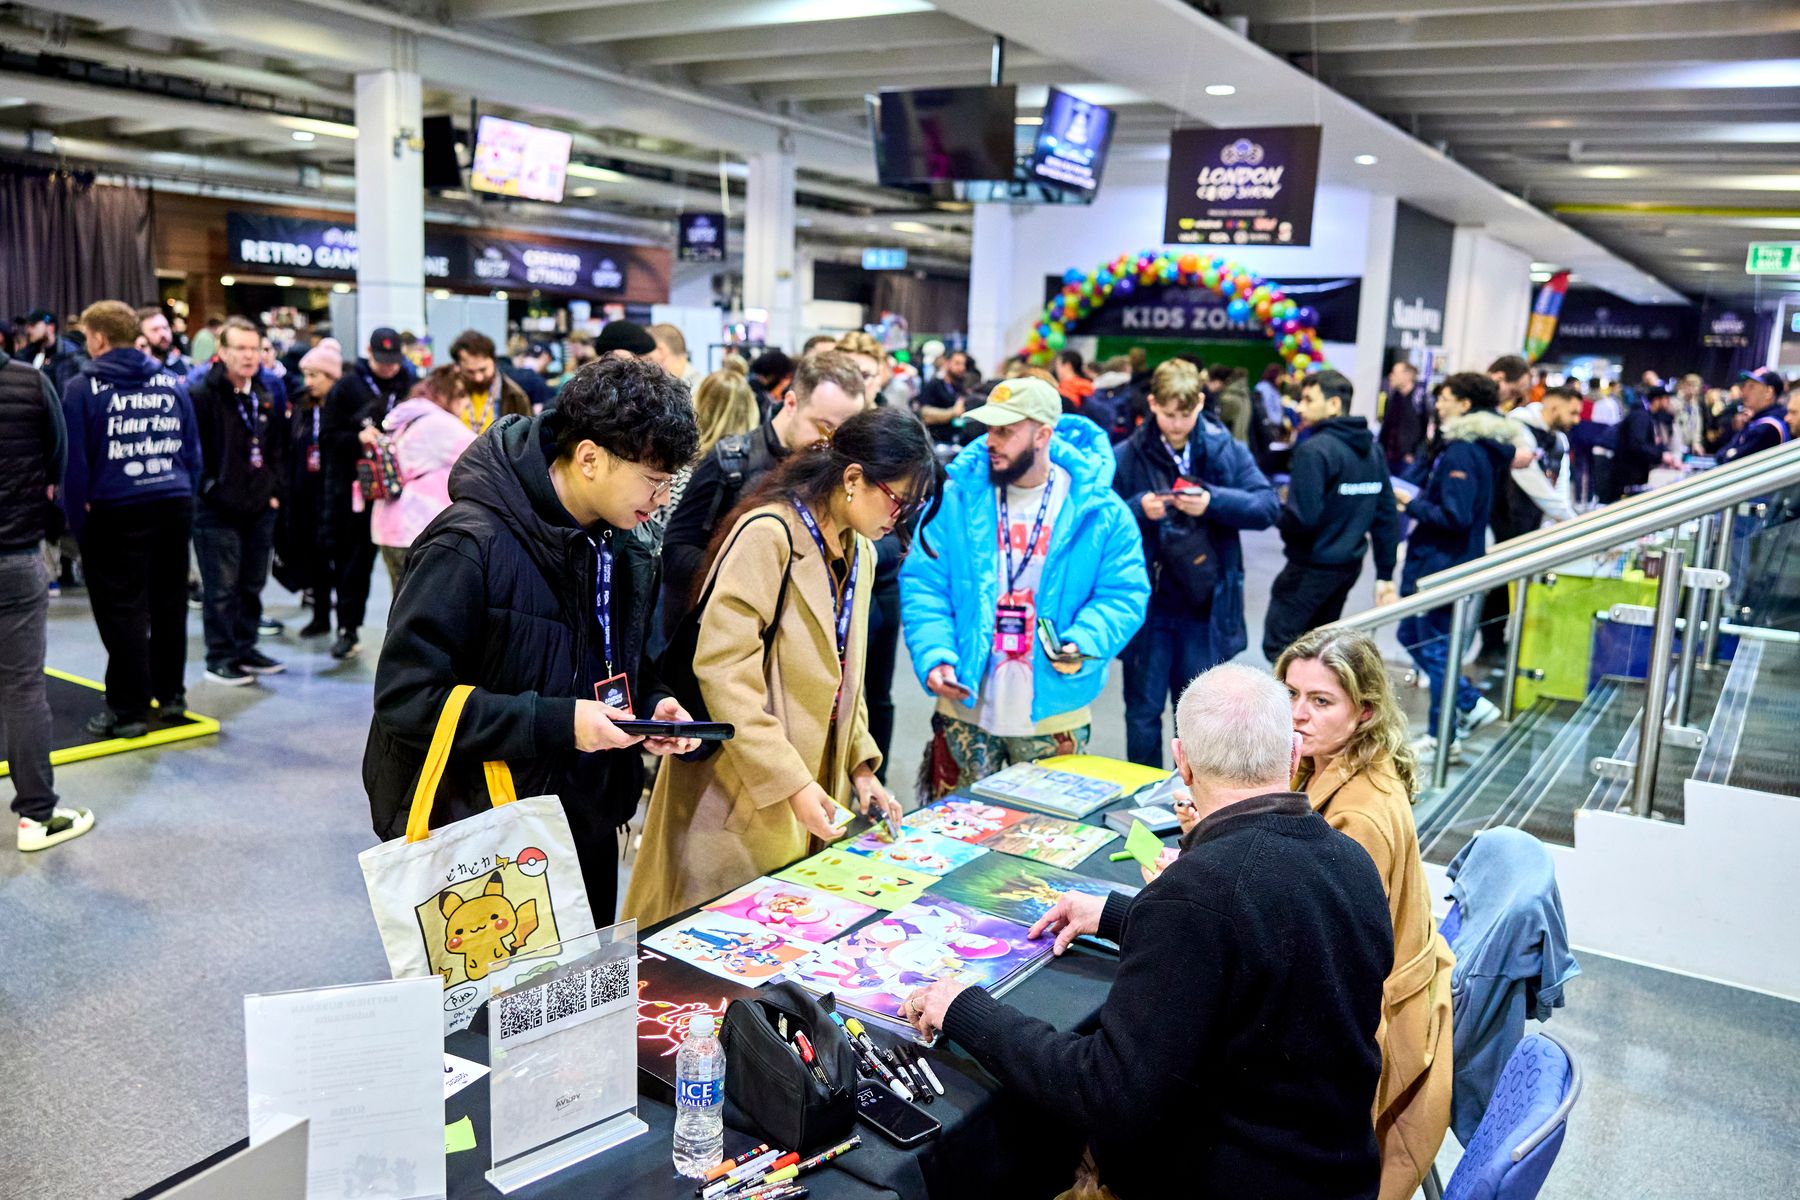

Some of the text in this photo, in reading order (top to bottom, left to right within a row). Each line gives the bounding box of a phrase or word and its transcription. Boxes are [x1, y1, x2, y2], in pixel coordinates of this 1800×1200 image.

[1197, 166, 1284, 186] LONDON
[1235, 183, 1282, 200] SHOW
[241, 239, 312, 267] RETRO
[313, 246, 359, 270] GAM
[424, 256, 449, 277] NE
[1122, 306, 1185, 329] KIDS
[106, 392, 176, 413] Artistry
[107, 415, 181, 437] Futurism
[681, 1081, 713, 1099] ICE
[681, 1096, 713, 1107] VALLEY
